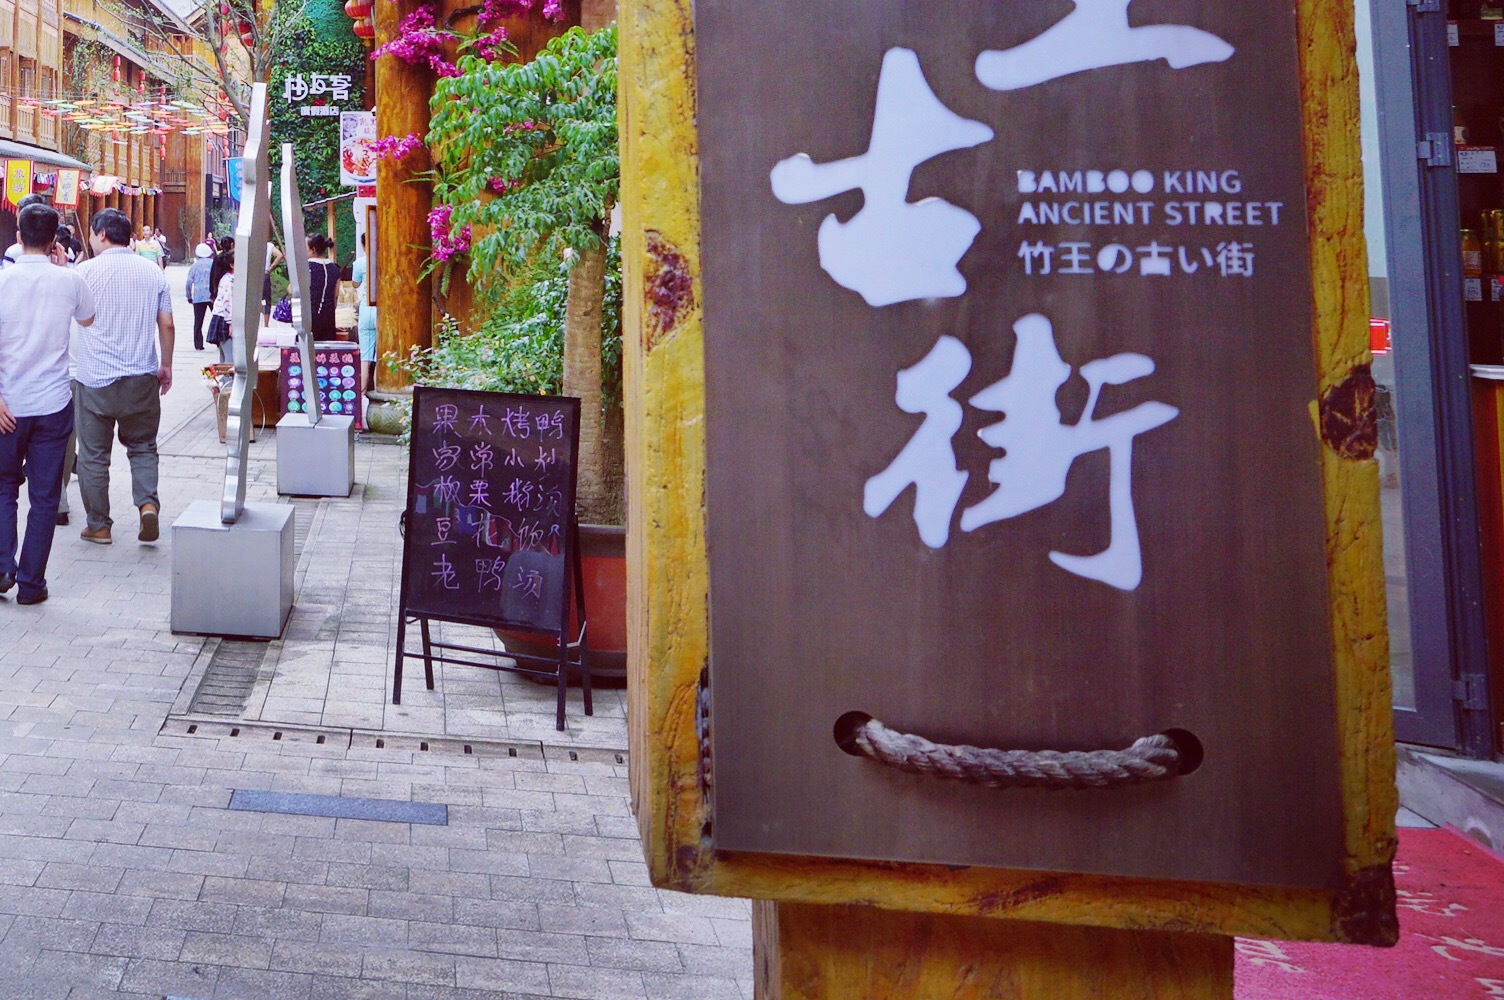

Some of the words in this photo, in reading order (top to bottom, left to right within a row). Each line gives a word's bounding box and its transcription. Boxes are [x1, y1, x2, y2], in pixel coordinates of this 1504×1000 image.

[1017, 169, 1155, 193] BAMBOO
[1163, 169, 1242, 193] KING
[1018, 201, 1154, 225] ANCIENT
[1164, 201, 1283, 225] STREET
[1017, 240, 1255, 277] 竹王の古い街
[432, 403, 565, 442] 果木烤鸭
